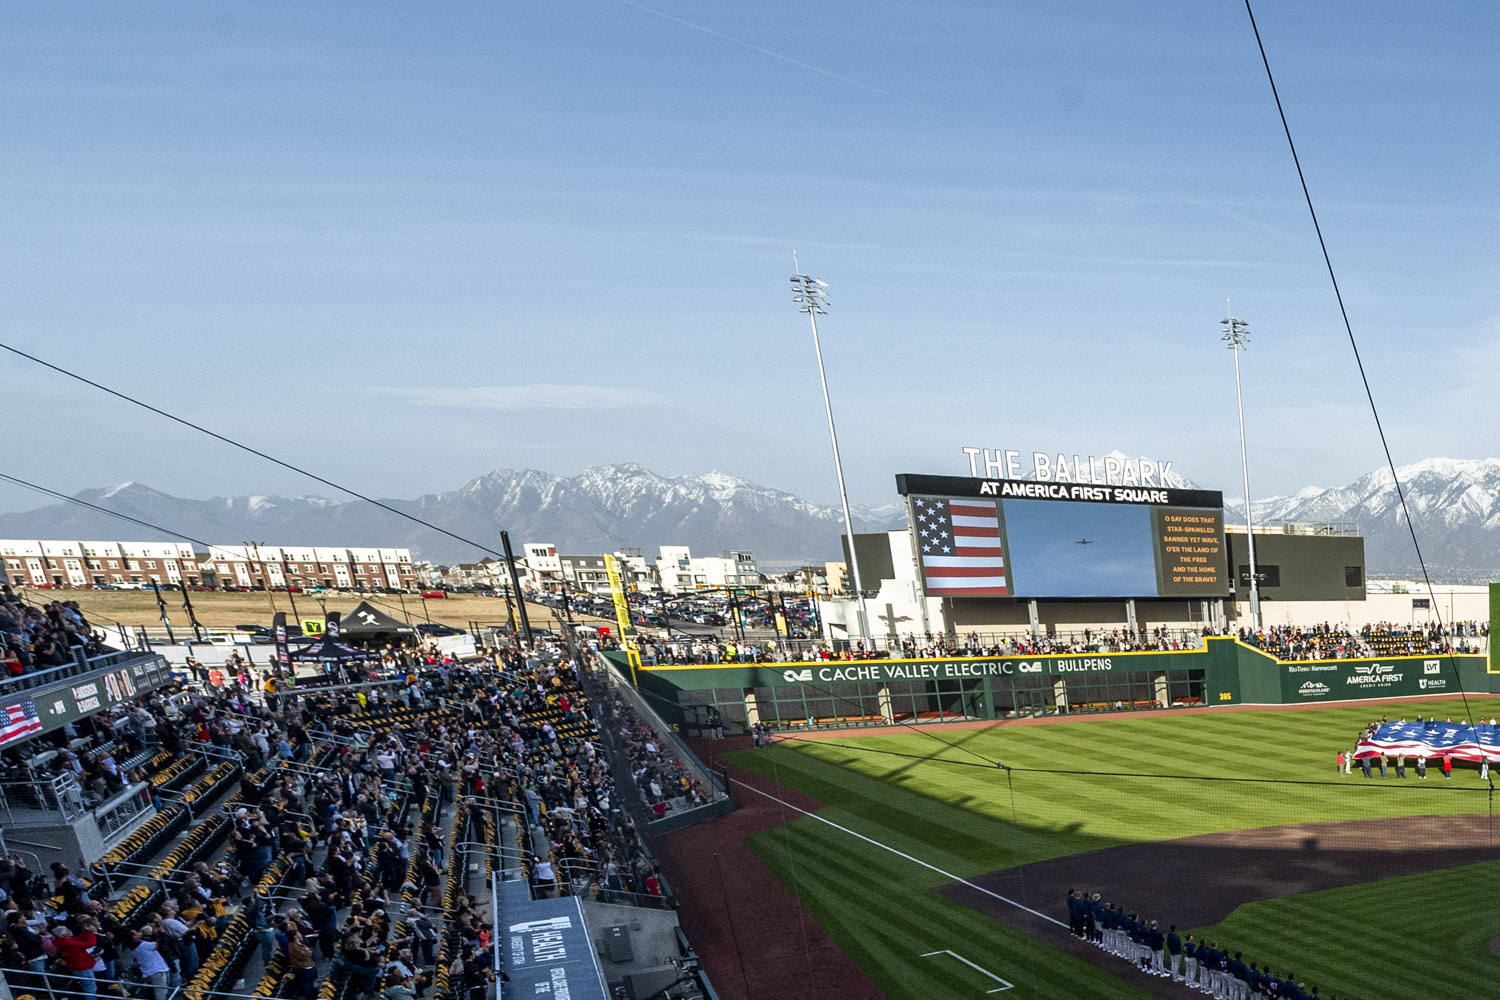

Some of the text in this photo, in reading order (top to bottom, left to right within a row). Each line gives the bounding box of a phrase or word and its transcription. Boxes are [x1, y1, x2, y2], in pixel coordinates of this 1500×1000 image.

[962, 447, 1175, 489] THE BALLPARK
[980, 482, 1169, 503] AT AMERICA FIRST SQUARE
[819, 665, 880, 681] CACHE
[884, 663, 940, 679] VALLEY
[945, 661, 1013, 677] ELECTRIC
[1058, 659, 1112, 673] BULLPENS
[1426, 663, 1437, 671] LVT
[1346, 674, 1403, 685] AMERICA FIRST
[531, 930, 567, 962] HEALTH
